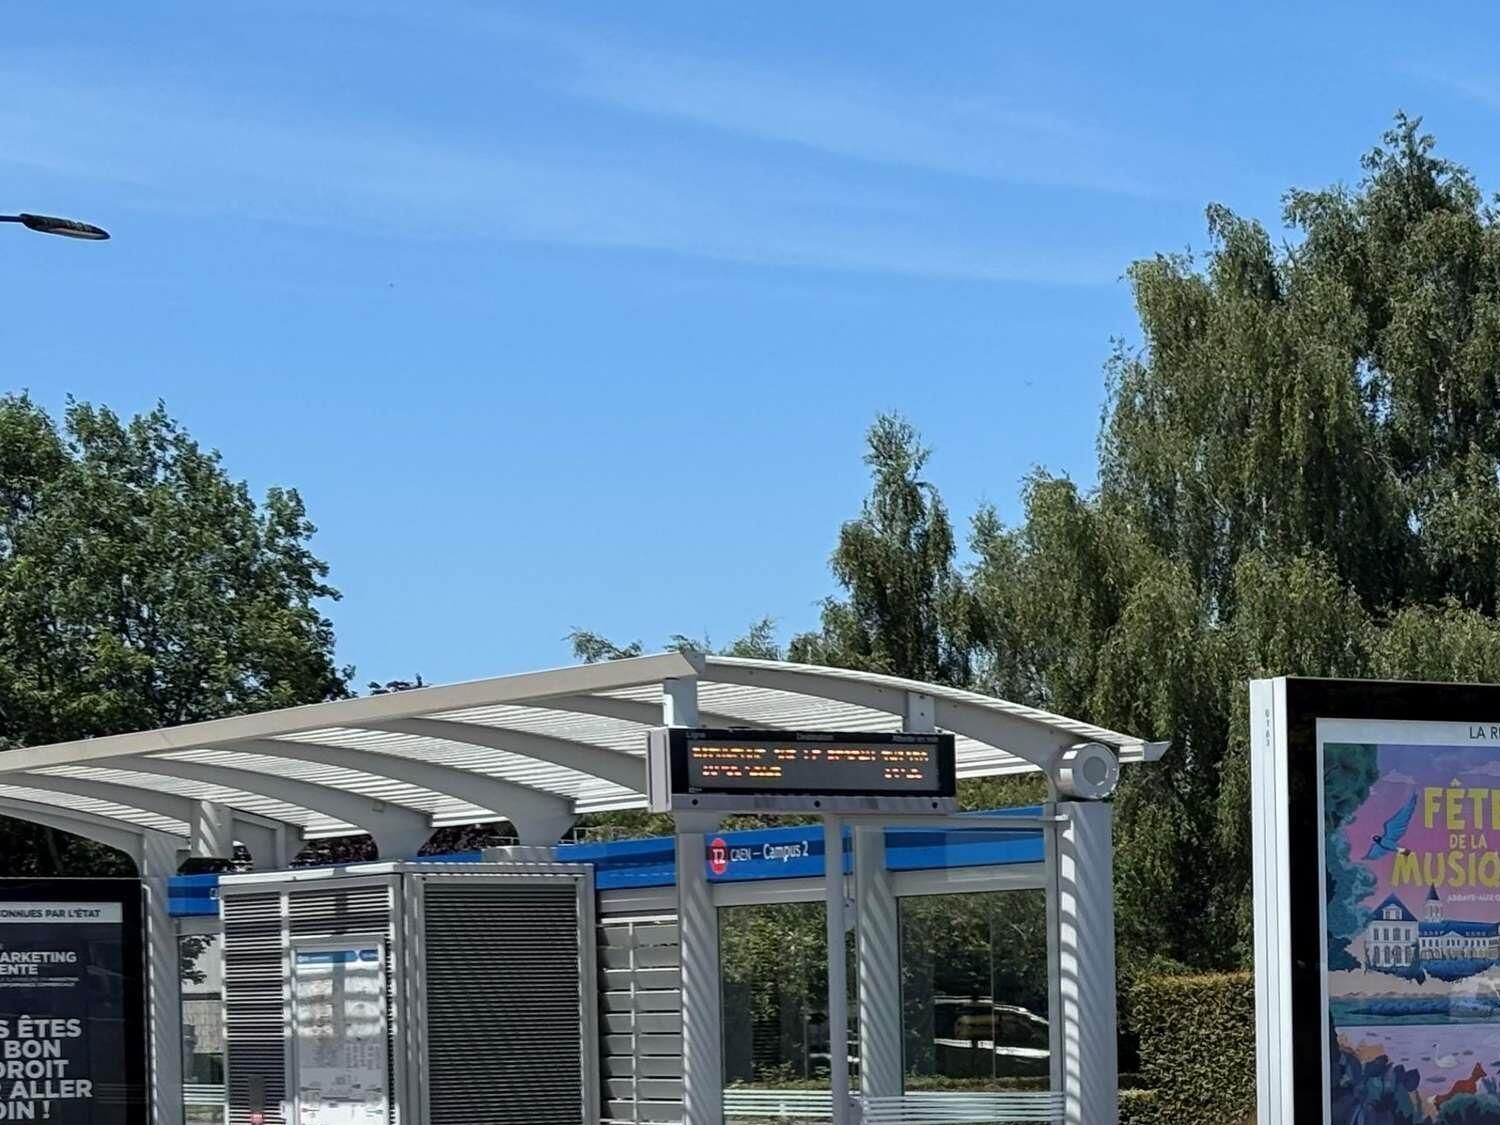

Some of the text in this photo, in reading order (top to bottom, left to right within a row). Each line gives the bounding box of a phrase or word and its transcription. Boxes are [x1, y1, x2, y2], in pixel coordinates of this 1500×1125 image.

[1469, 726, 1486, 740] LA
[1449, 833, 1488, 849] DE LA
[712, 840, 809, 865] T2 CAEN Campus 2
[45, 908, 66, 918] PAR
[67, 907, 102, 918] L'ÉTAT
[18, 1014, 82, 1038] ÊTES
[4, 1039, 61, 1059] BON
[9, 1079, 93, 1099] ALLER
